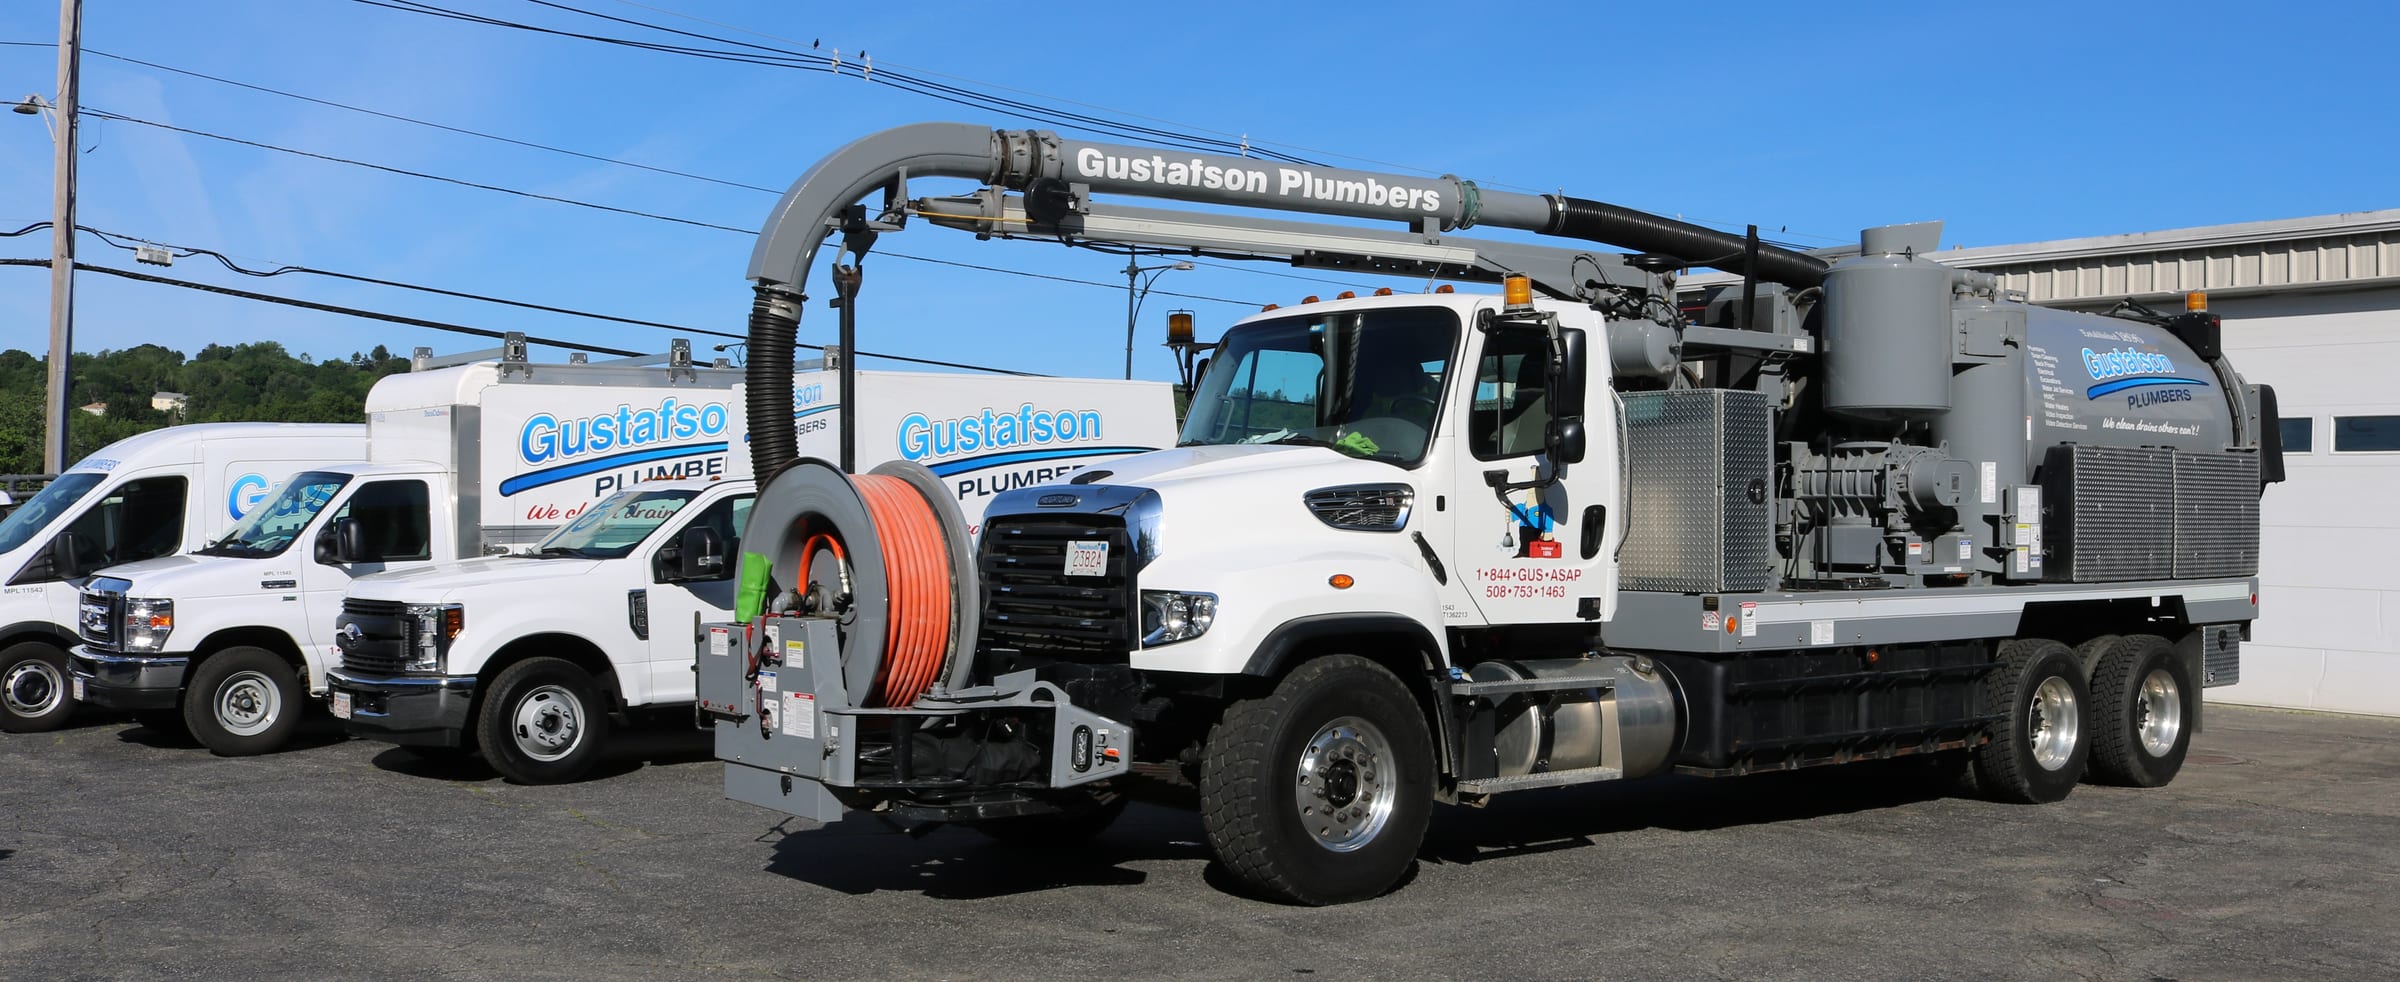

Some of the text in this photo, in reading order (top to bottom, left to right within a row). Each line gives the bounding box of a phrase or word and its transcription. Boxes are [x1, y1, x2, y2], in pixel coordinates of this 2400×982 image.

[1077, 148, 1440, 212] Gustafson Plumbers
[2082, 347, 2175, 380] Gustafson
[2128, 389, 2192, 410] PLUMBERS
[520, 397, 729, 465] Gustafso
[897, 402, 1102, 461] Gustafson
[2103, 417, 2114, 429] We
[2116, 418, 2135, 431] clean
[527, 504, 560, 520] We
